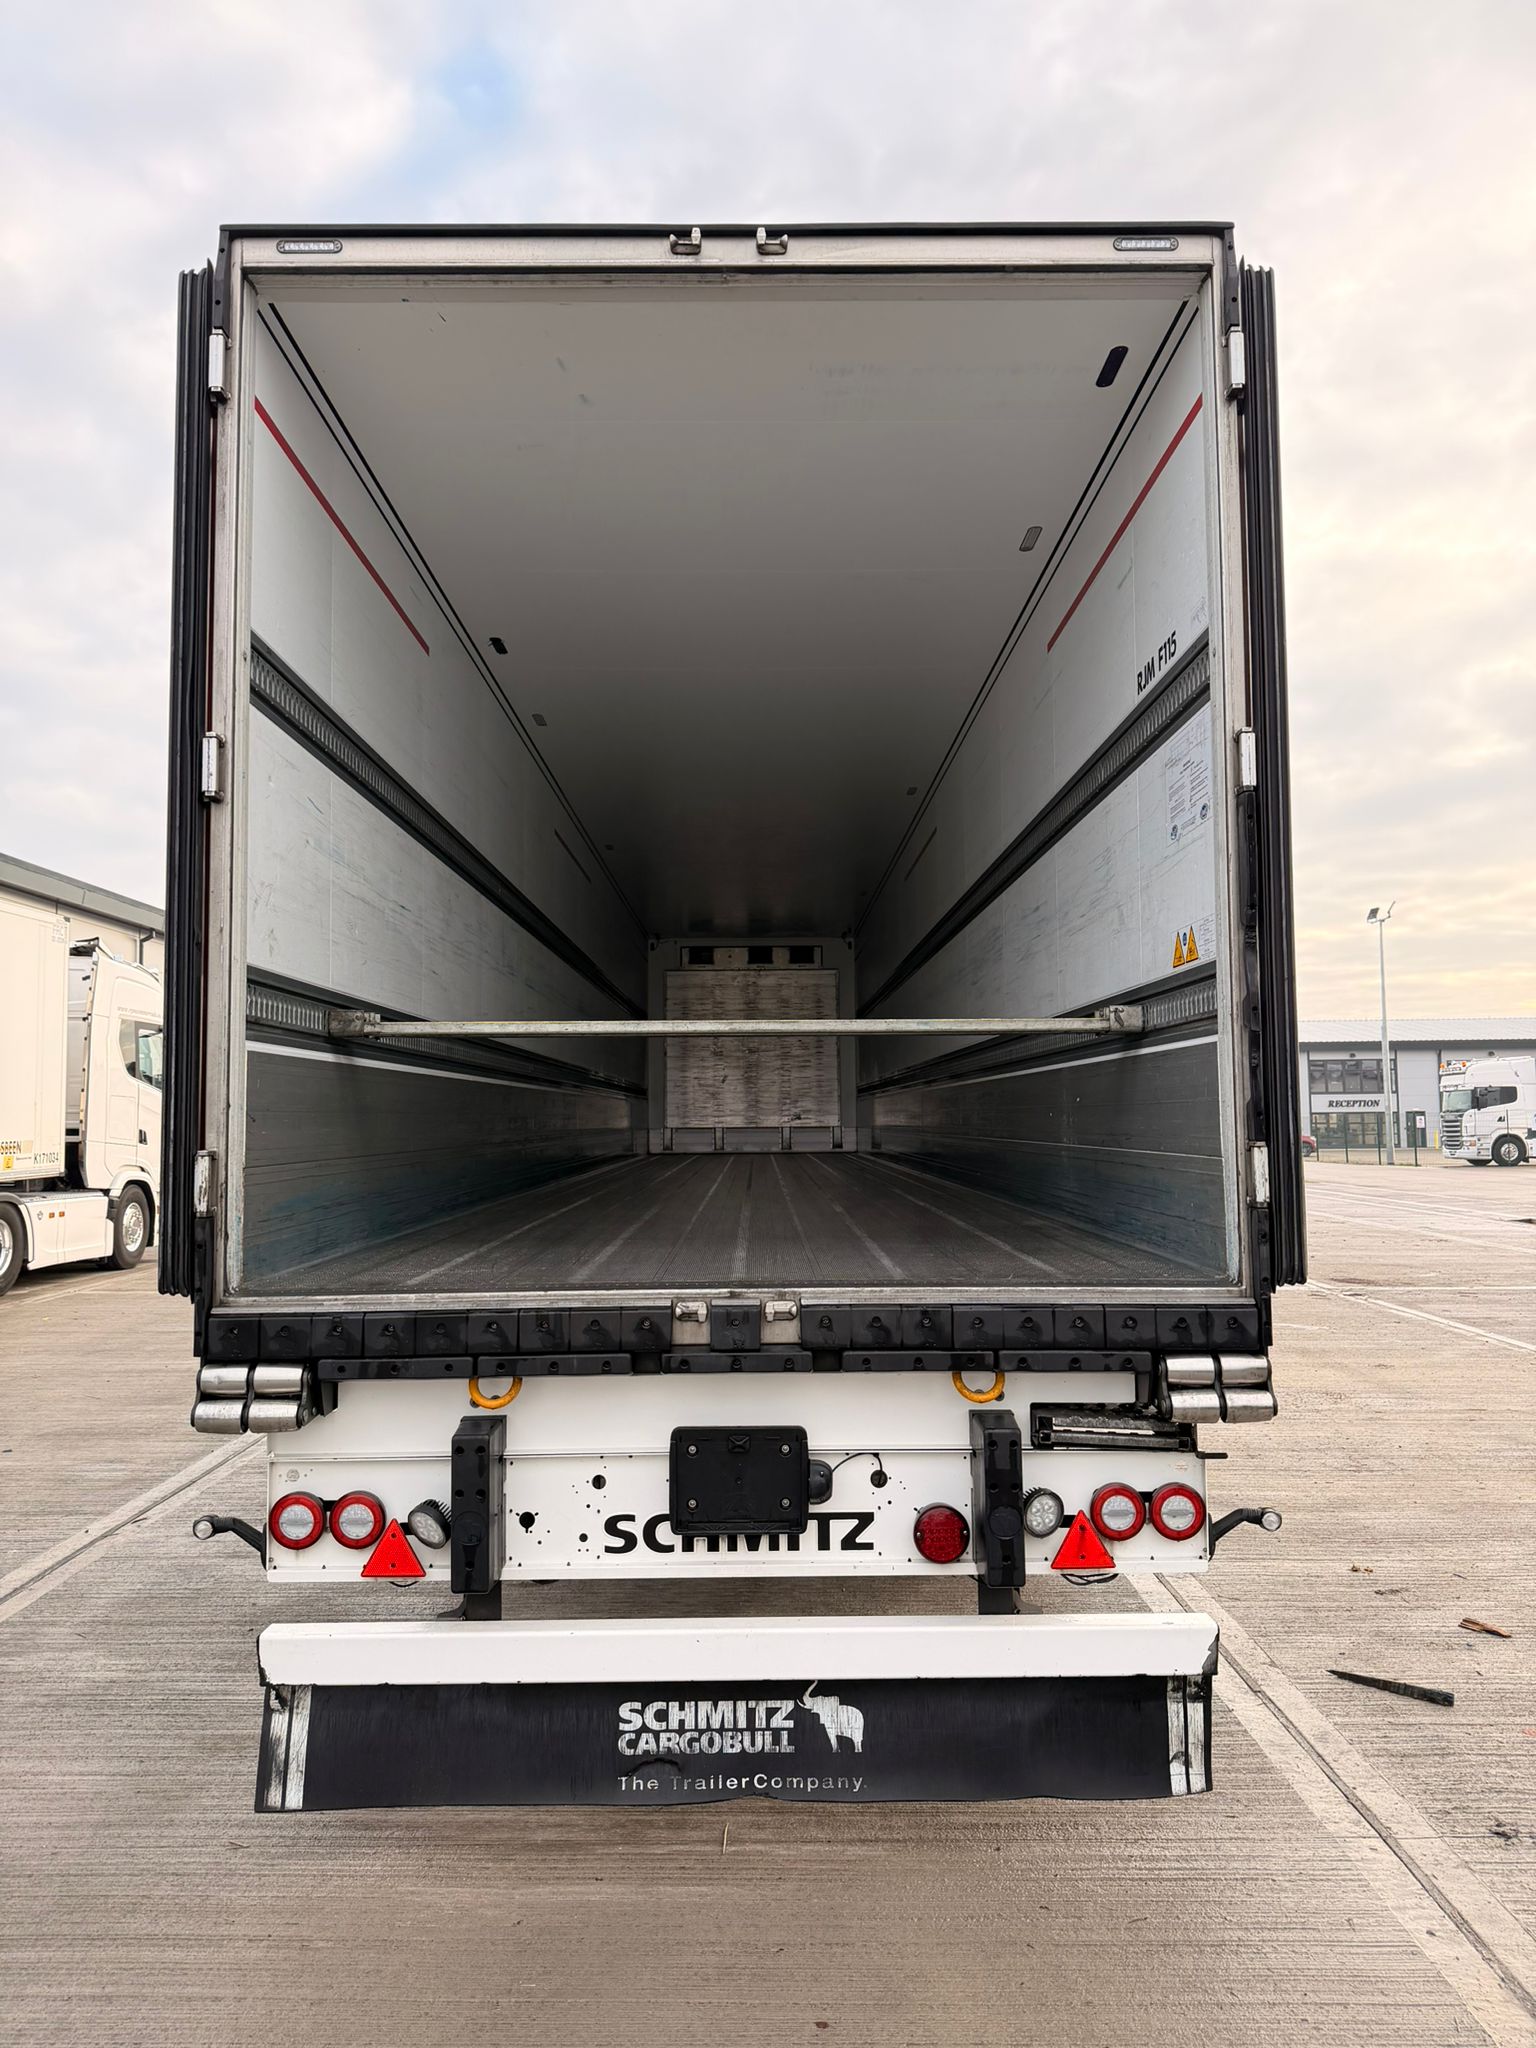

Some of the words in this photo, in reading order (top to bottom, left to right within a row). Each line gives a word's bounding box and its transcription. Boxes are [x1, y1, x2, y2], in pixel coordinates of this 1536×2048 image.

[1137, 656, 1155, 695] RJM
[1158, 630, 1177, 672] F115
[1328, 1100, 1380, 1108] RECEPTION
[618, 1700, 795, 1731] SCHMITZ
[618, 1731, 796, 1756] CARGOBULL
[617, 1775, 659, 1792] The
